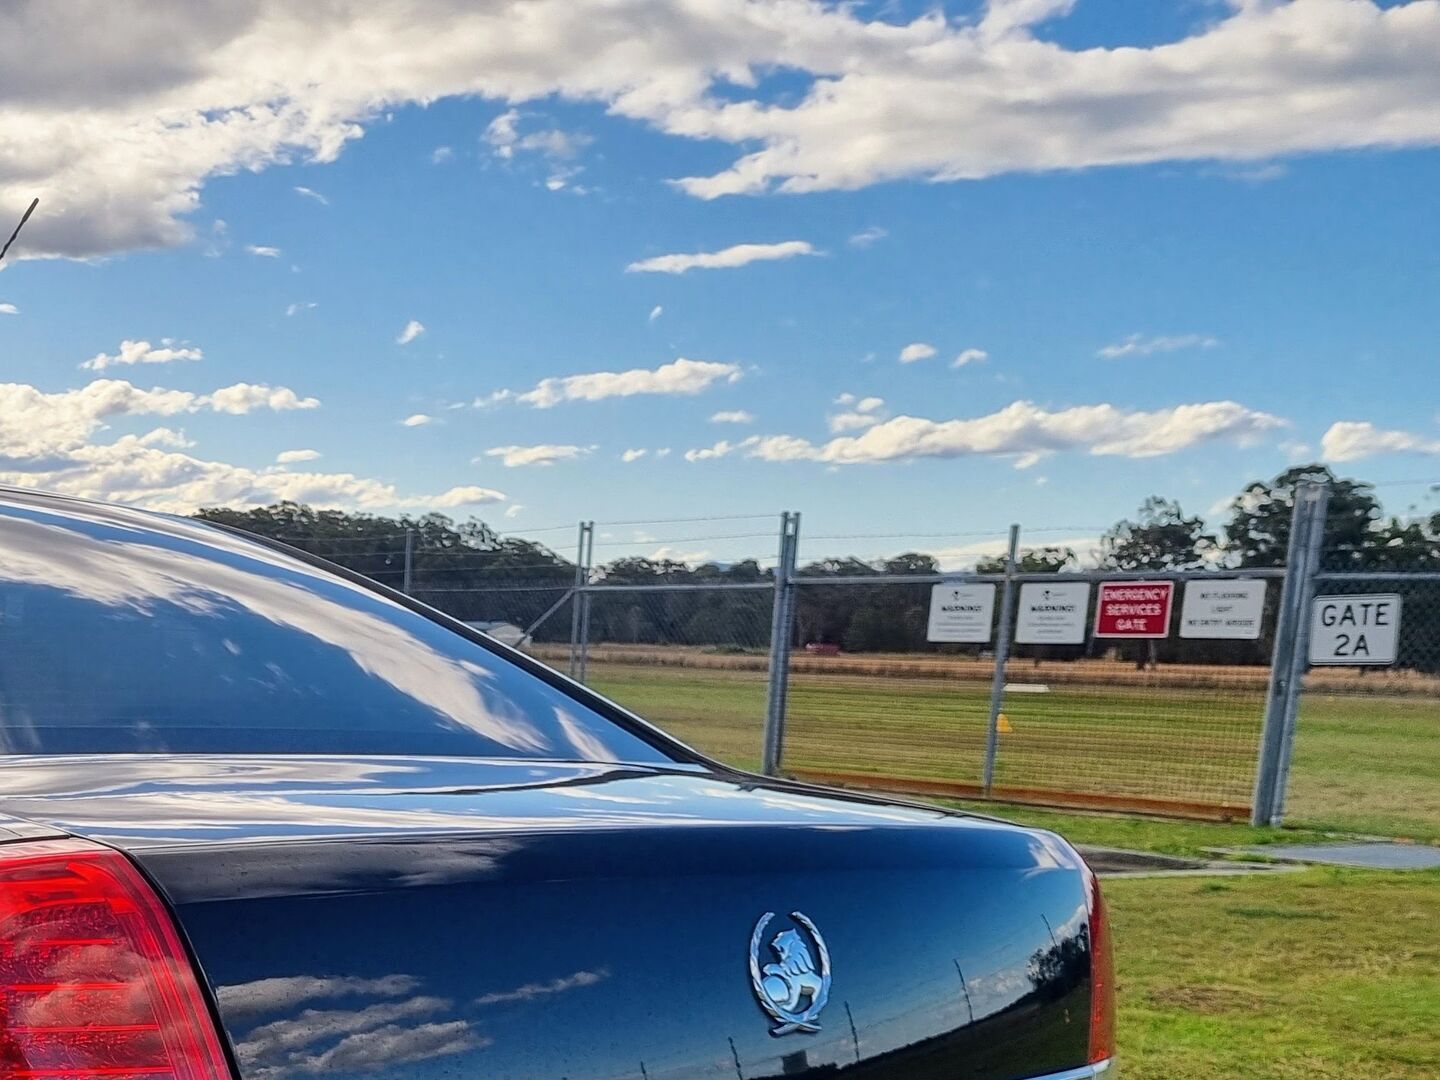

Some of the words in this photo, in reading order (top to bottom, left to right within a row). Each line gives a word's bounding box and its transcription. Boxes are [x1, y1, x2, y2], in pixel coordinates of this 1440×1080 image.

[1103, 588, 1169, 601] EMERGENCY
[1105, 603, 1162, 616] SERVICES
[1321, 603, 1390, 627] GATE
[1115, 618, 1148, 631] GATE
[1333, 634, 1370, 656] 2A
